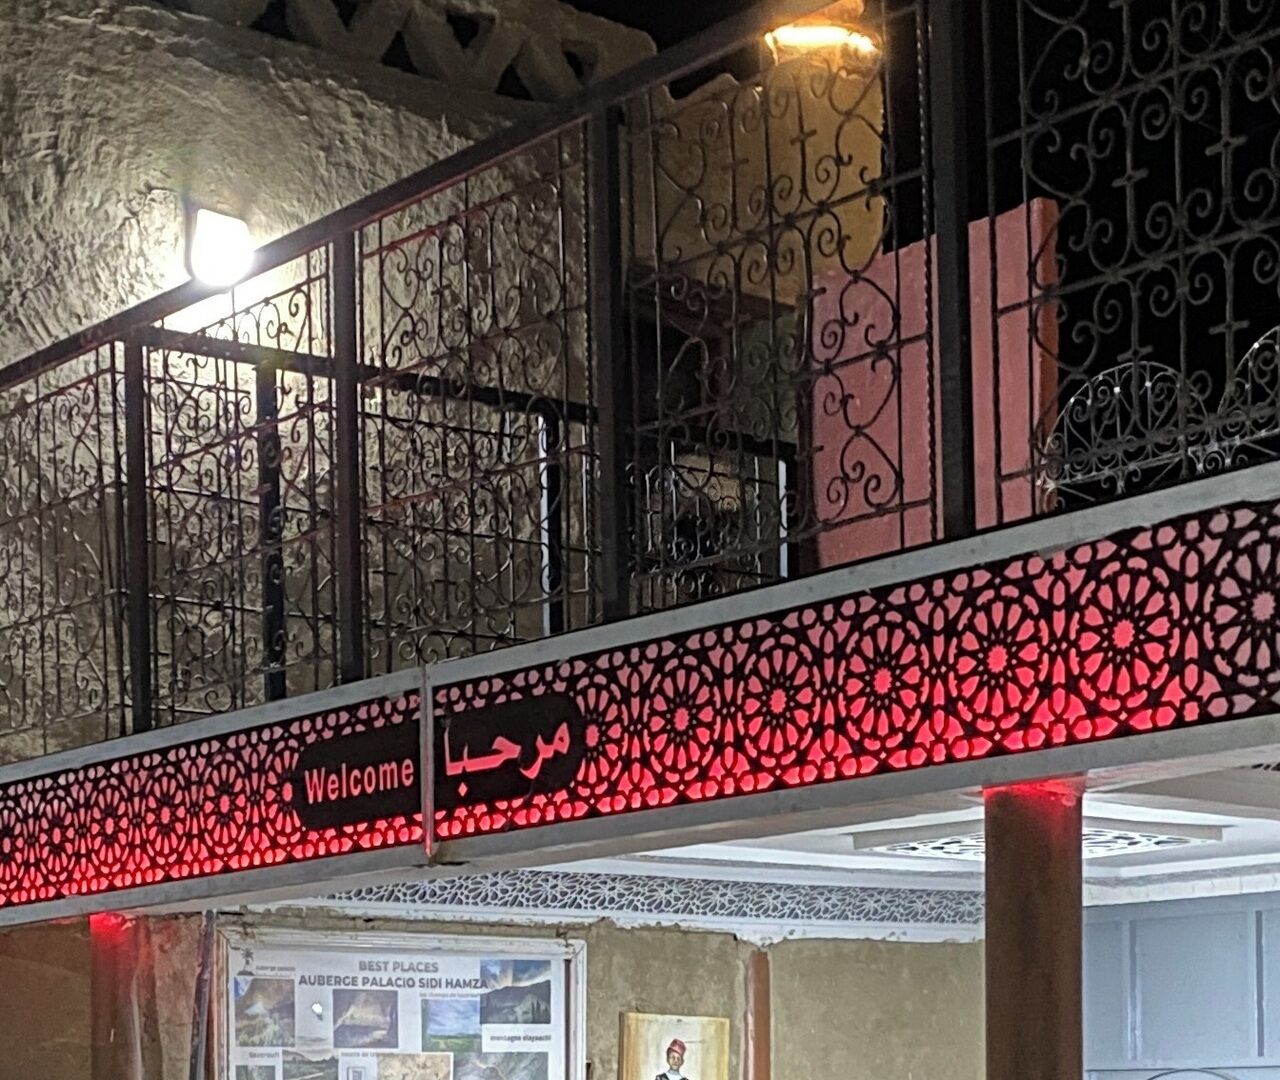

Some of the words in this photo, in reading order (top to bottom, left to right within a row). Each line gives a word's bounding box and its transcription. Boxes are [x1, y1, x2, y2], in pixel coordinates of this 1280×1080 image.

[444, 721, 571, 797] مرحبا
[304, 756, 415, 805] Welcome
[298, 975, 358, 987] AUBERGE
[362, 976, 415, 988] PALACIO
[419, 977, 442, 989] SIDI
[445, 978, 488, 989] HAMZA
[358, 961, 389, 972] BEST
[393, 961, 439, 973] PLACES
